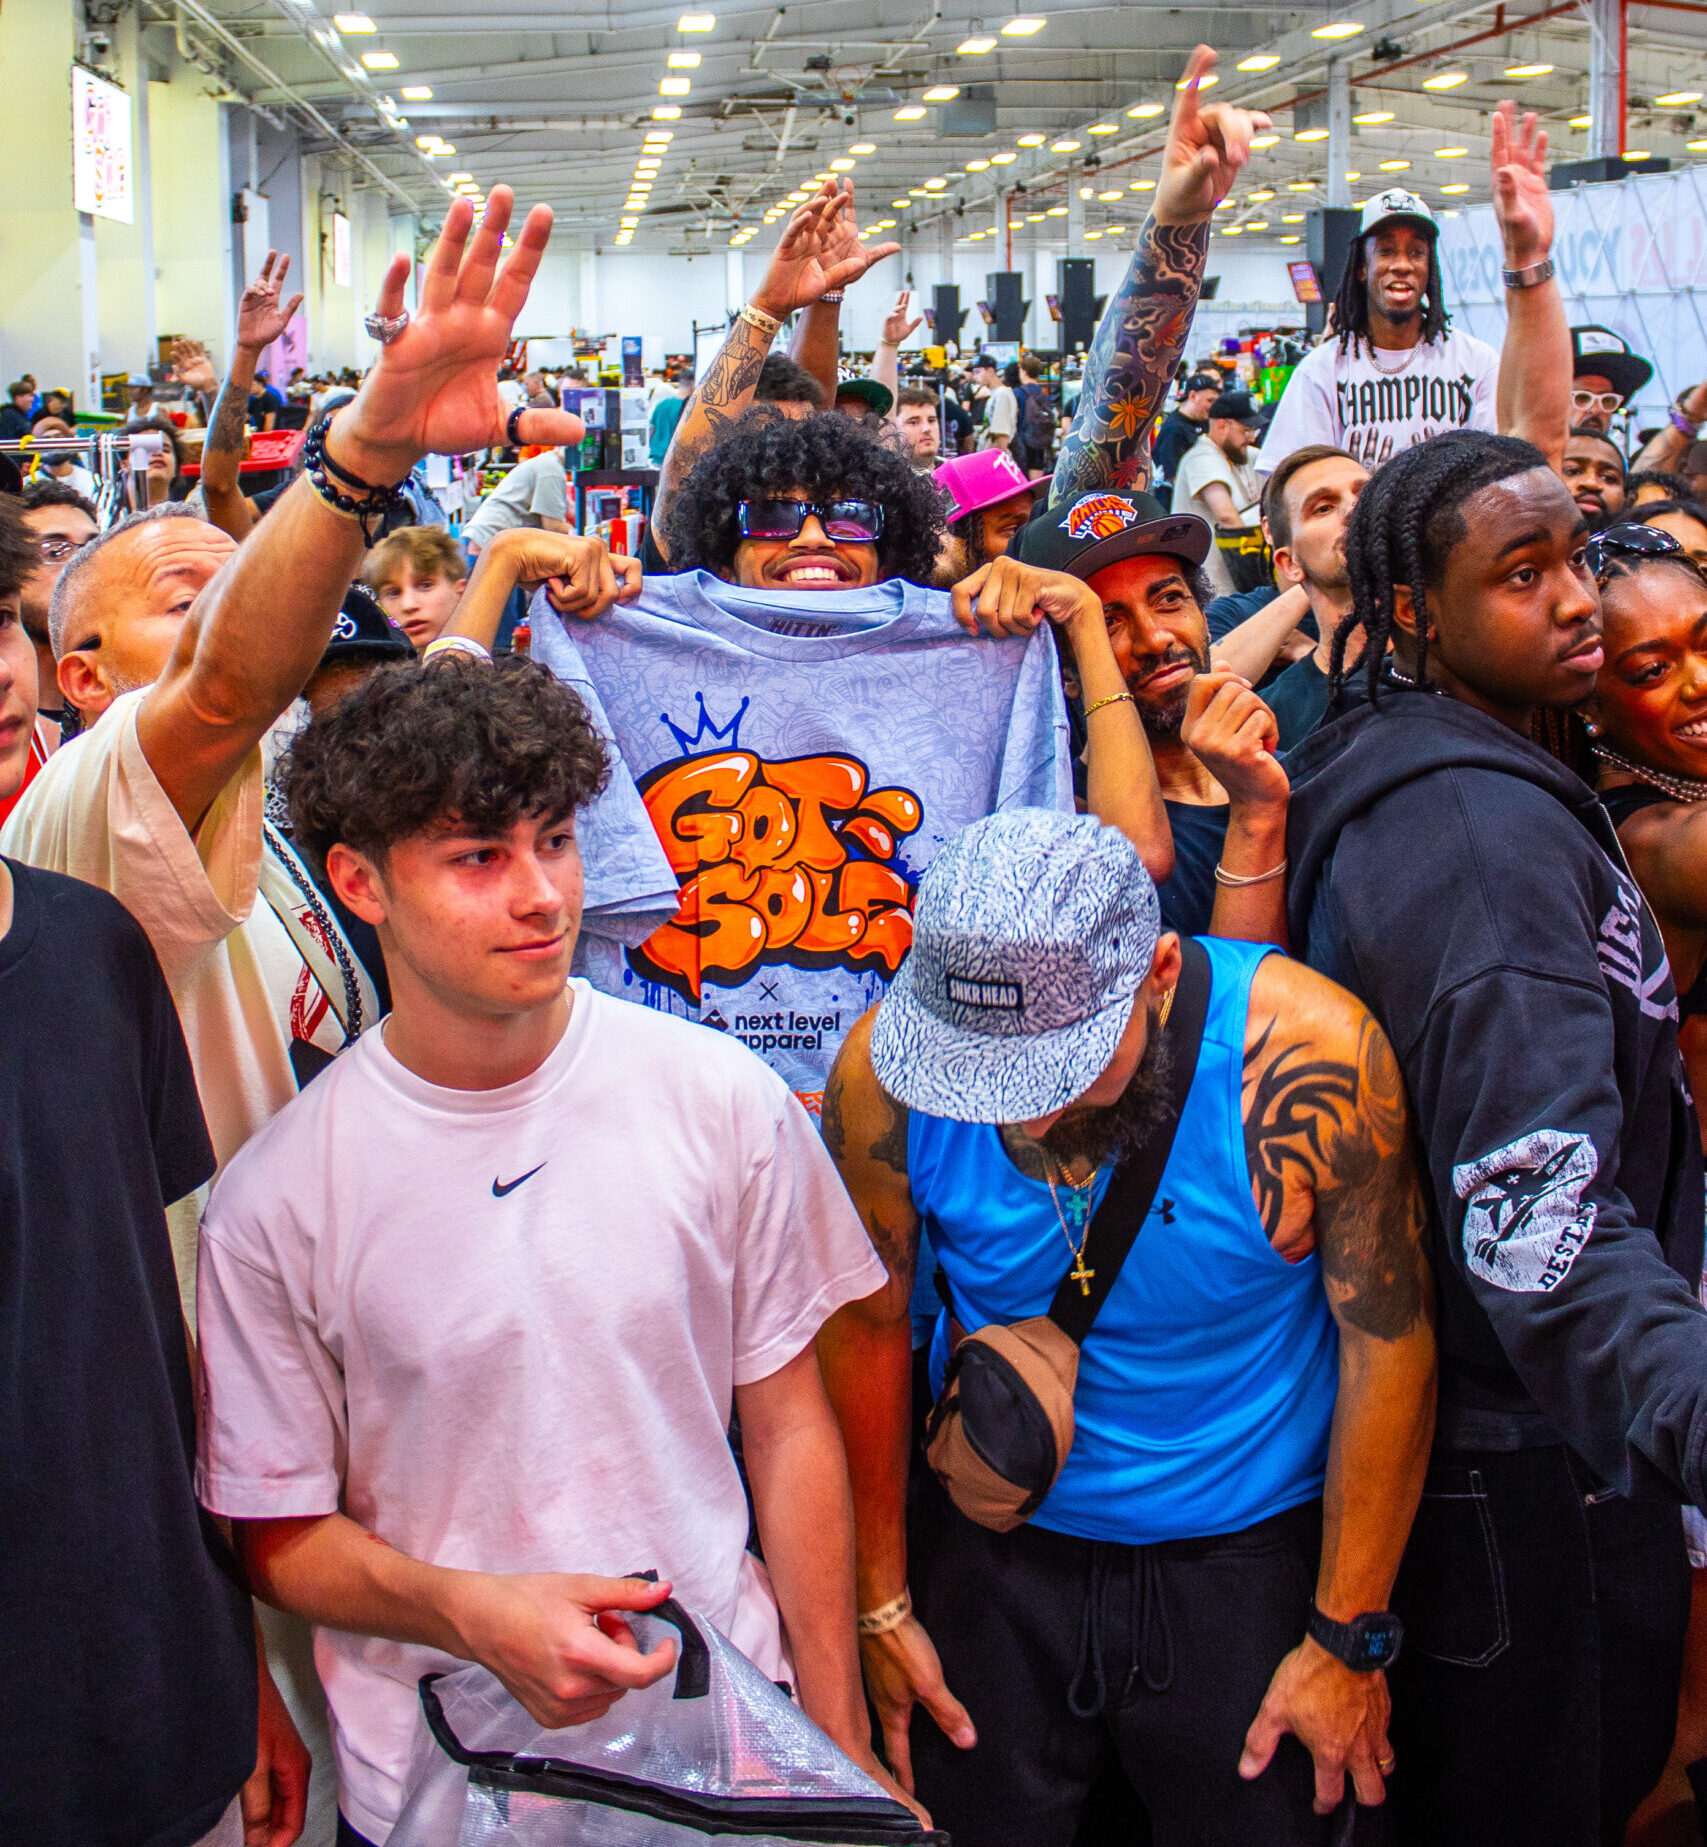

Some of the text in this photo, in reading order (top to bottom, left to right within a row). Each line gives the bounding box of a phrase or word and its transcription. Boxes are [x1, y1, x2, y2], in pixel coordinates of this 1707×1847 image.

[1336, 373, 1476, 428] CHAMPIONS
[1069, 494, 1136, 535] KNICKS
[641, 750, 867, 876] GOT
[640, 860, 913, 999] SOLE
[735, 1011, 840, 1031] next level
